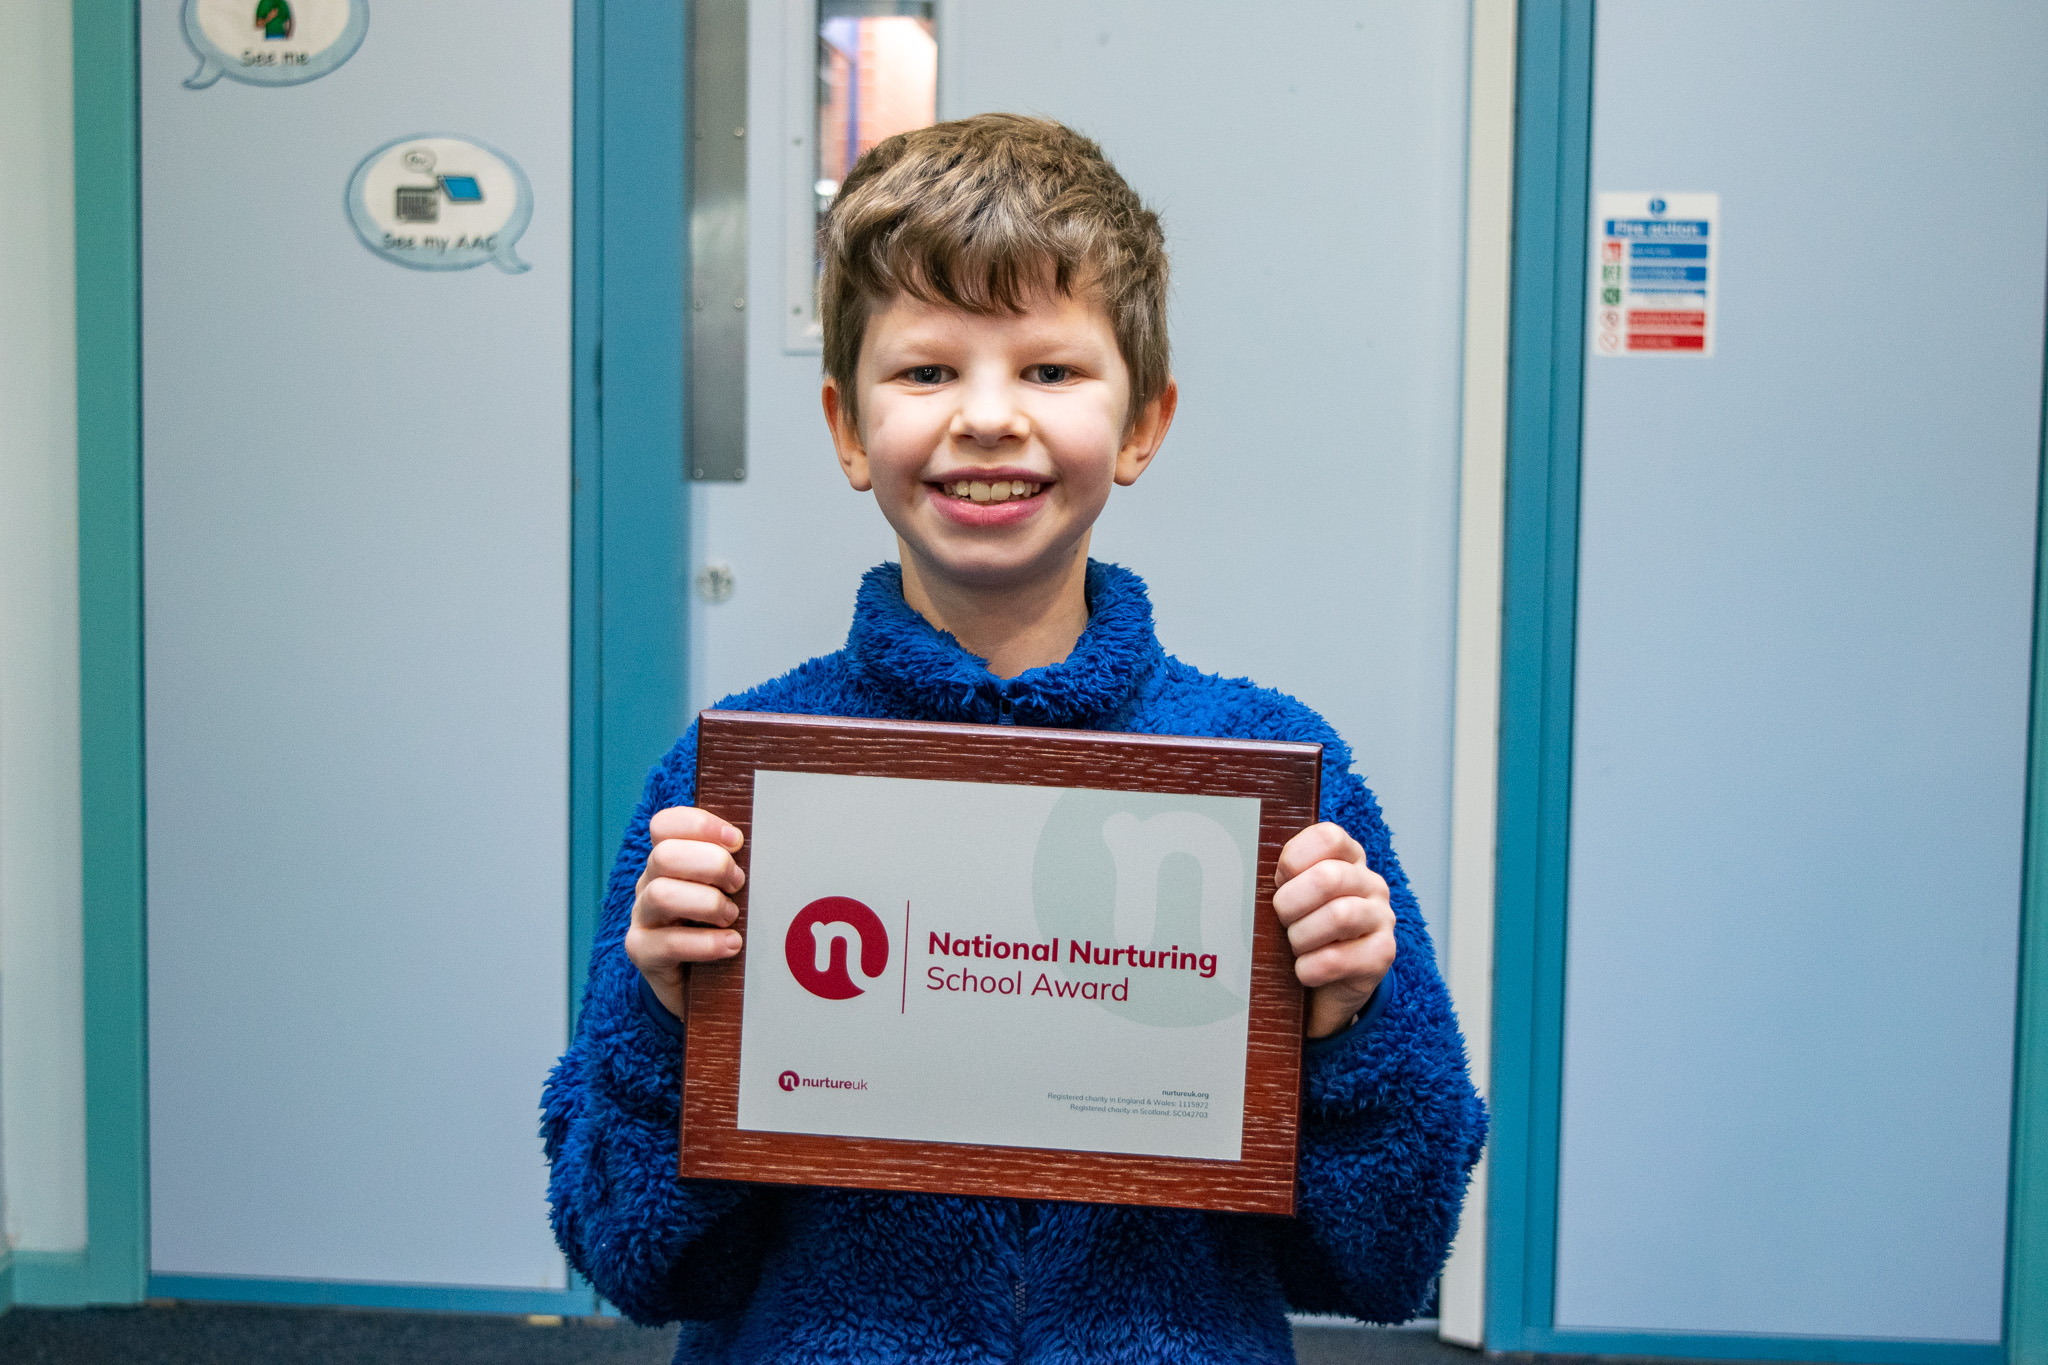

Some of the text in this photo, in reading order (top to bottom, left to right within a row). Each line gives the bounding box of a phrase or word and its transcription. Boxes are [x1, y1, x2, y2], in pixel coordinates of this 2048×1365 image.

[240, 50, 309, 67] See me
[383, 233, 415, 251] See
[424, 235, 449, 255] my
[928, 931, 1218, 978] National Nurturing
[926, 965, 1130, 1002] School Award
[802, 1077, 868, 1091] nurtureuk
[1047, 1092, 1084, 1101] Registered
[1085, 1094, 1108, 1103] charity
[1117, 1097, 1145, 1105] England
[1153, 1099, 1177, 1107] Wales:
[1178, 1100, 1209, 1109] 1115972
[1162, 1089, 1209, 1099] nurtureuk.org
[1070, 1104, 1106, 1113] Registered
[1107, 1106, 1131, 1115] charity
[1140, 1108, 1170, 1116] Scotland:
[1172, 1109, 1209, 1119] SC042703
